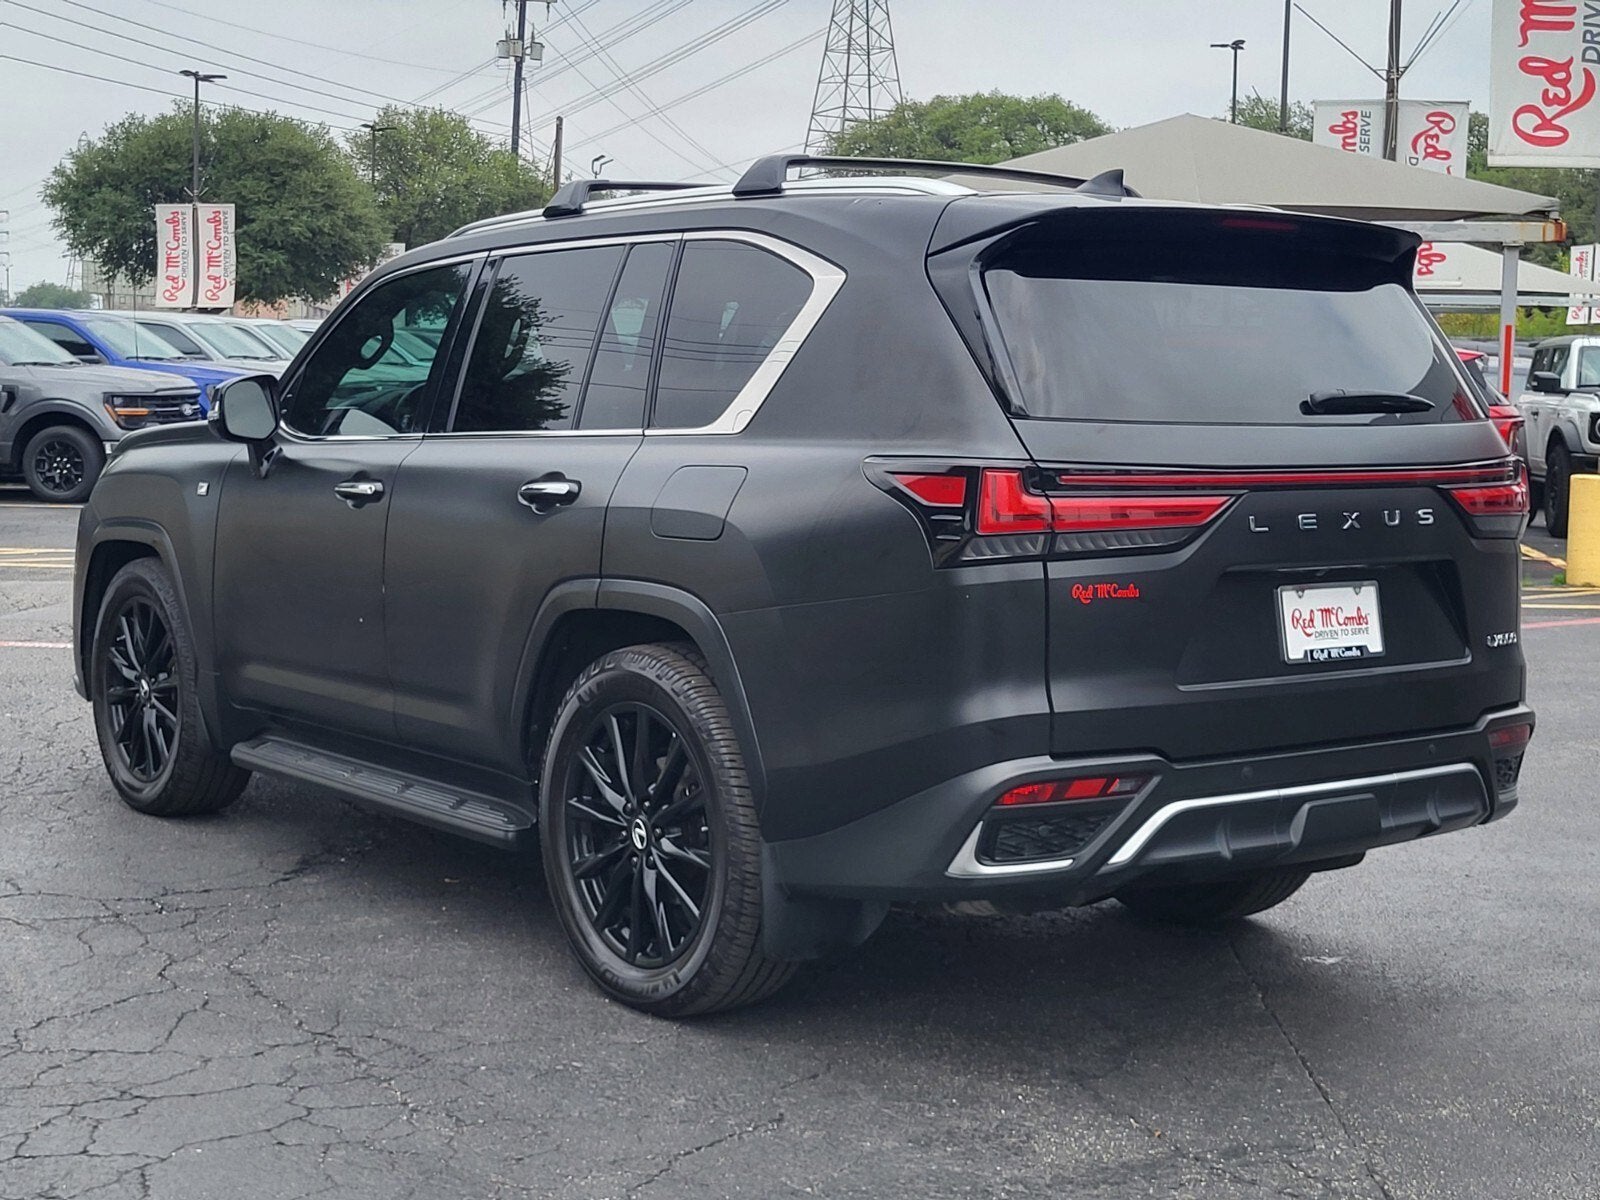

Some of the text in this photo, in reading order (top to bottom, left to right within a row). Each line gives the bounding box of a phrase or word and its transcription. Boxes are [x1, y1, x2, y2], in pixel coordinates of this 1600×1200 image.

[1581, 0, 1600, 66] DRIV
[1512, 56, 1597, 148] Red
[1359, 110, 1372, 153] SERVE
[1411, 111, 1457, 161] Red
[163, 211, 185, 302] Red McCombs
[181, 236, 187, 247] TO
[205, 210, 227, 302] Red McCombs
[223, 236, 229, 247] TO
[1249, 508, 1435, 533] LEXUS
[1072, 583, 1140, 604] Red McCombs
[1291, 606, 1369, 637] Red McCombs
[1314, 629, 1339, 639] DRIVEN
[1350, 627, 1370, 636] SERVE
[1312, 647, 1361, 660] Red McCombs
